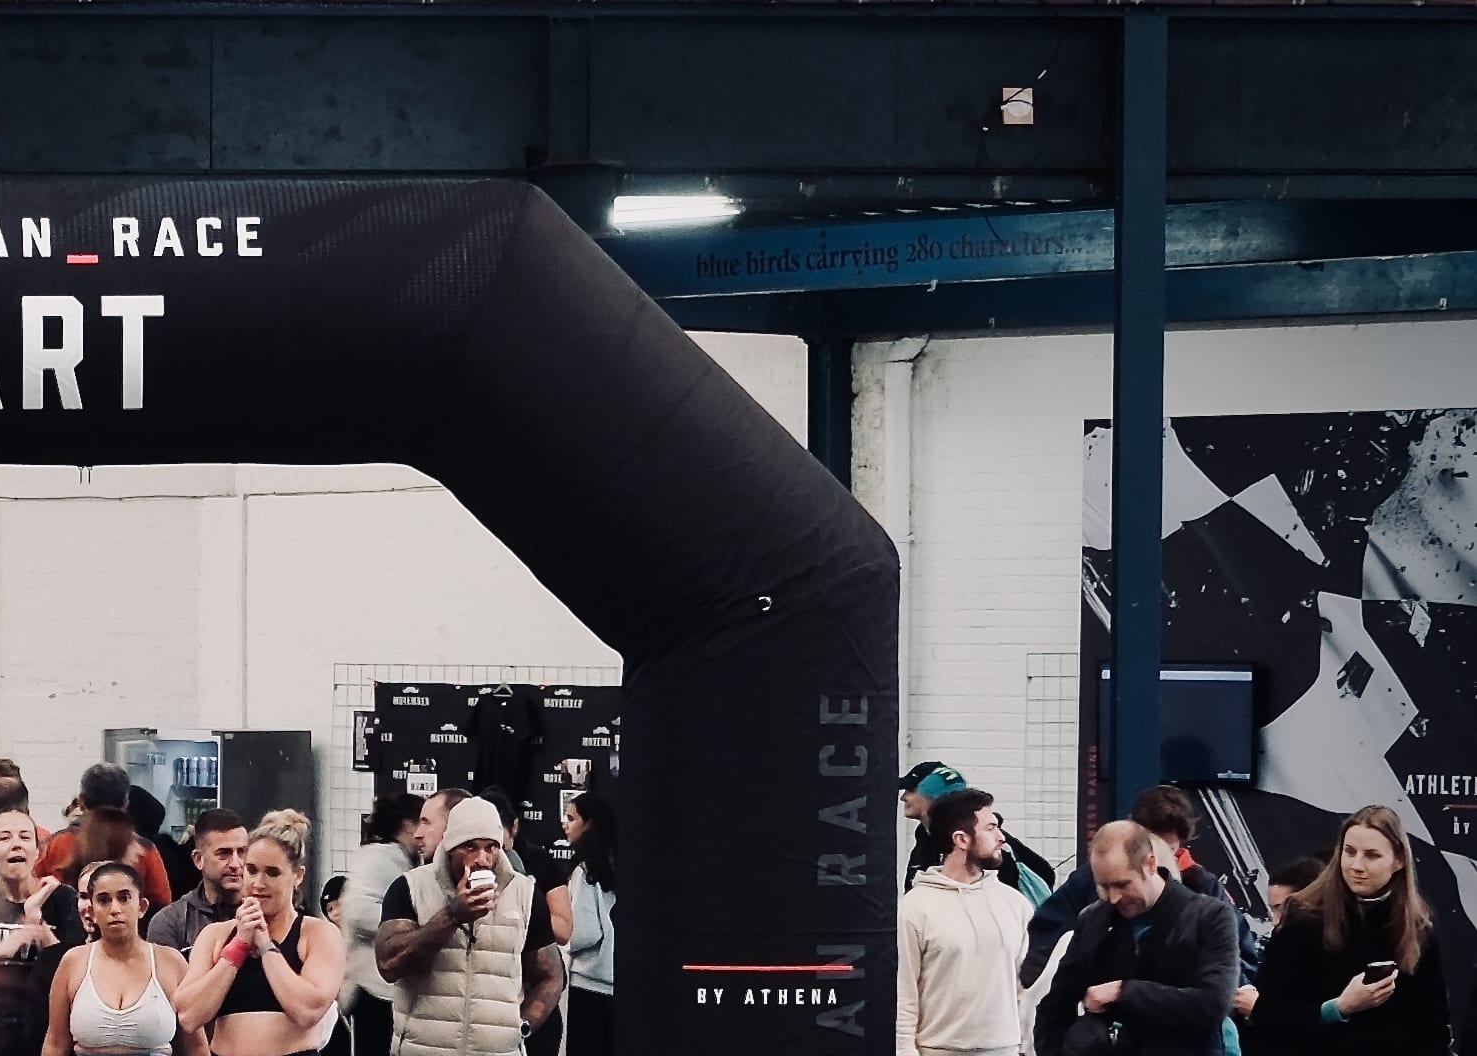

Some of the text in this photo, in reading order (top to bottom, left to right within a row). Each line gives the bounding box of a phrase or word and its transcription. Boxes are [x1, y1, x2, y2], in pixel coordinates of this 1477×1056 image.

[697, 253, 740, 279] blue
[746, 246, 800, 275] birds
[806, 241, 899, 273] carrying
[906, 233, 943, 263] 280
[817, 693, 869, 886] RACE
[1406, 774, 1477, 796] ATHLET
[697, 988, 837, 1005] BY ATHENA
